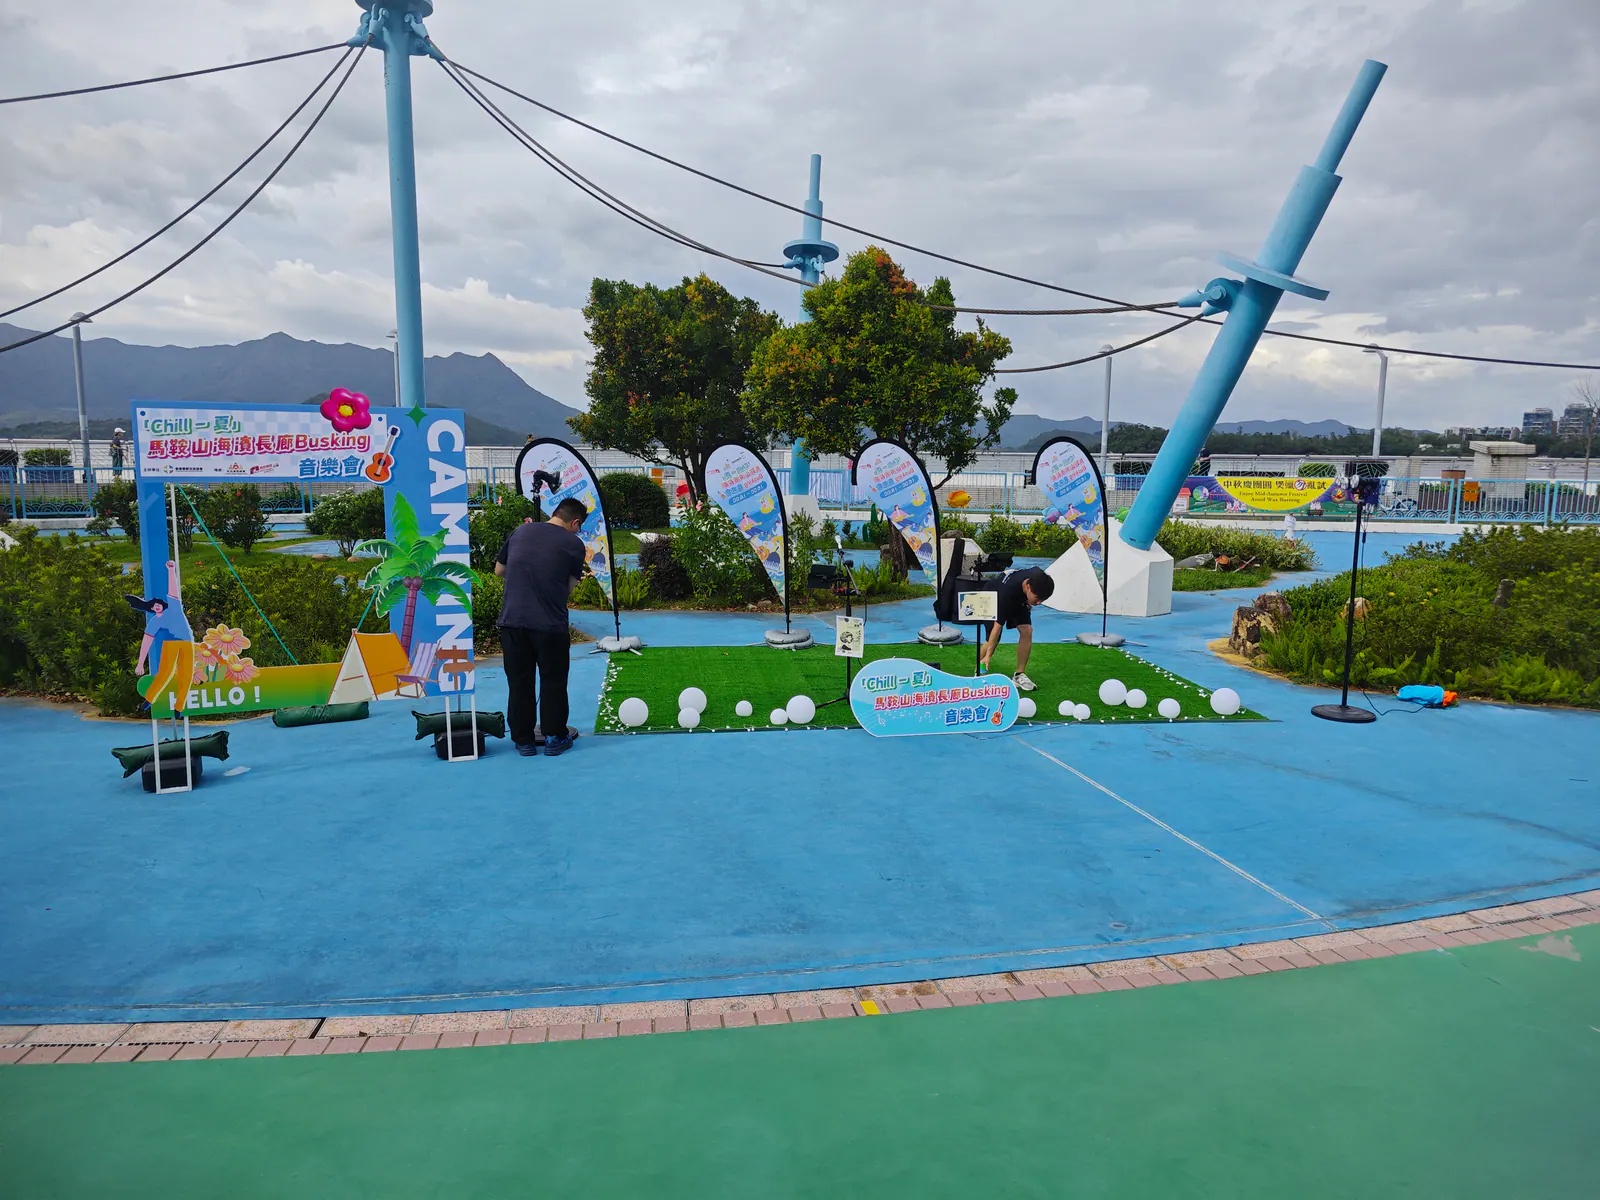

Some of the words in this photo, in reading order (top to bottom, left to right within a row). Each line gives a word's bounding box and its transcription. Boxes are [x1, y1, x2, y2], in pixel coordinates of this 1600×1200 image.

[299, 454, 361, 478] 音樂會
[945, 704, 989, 725] 音樂會
